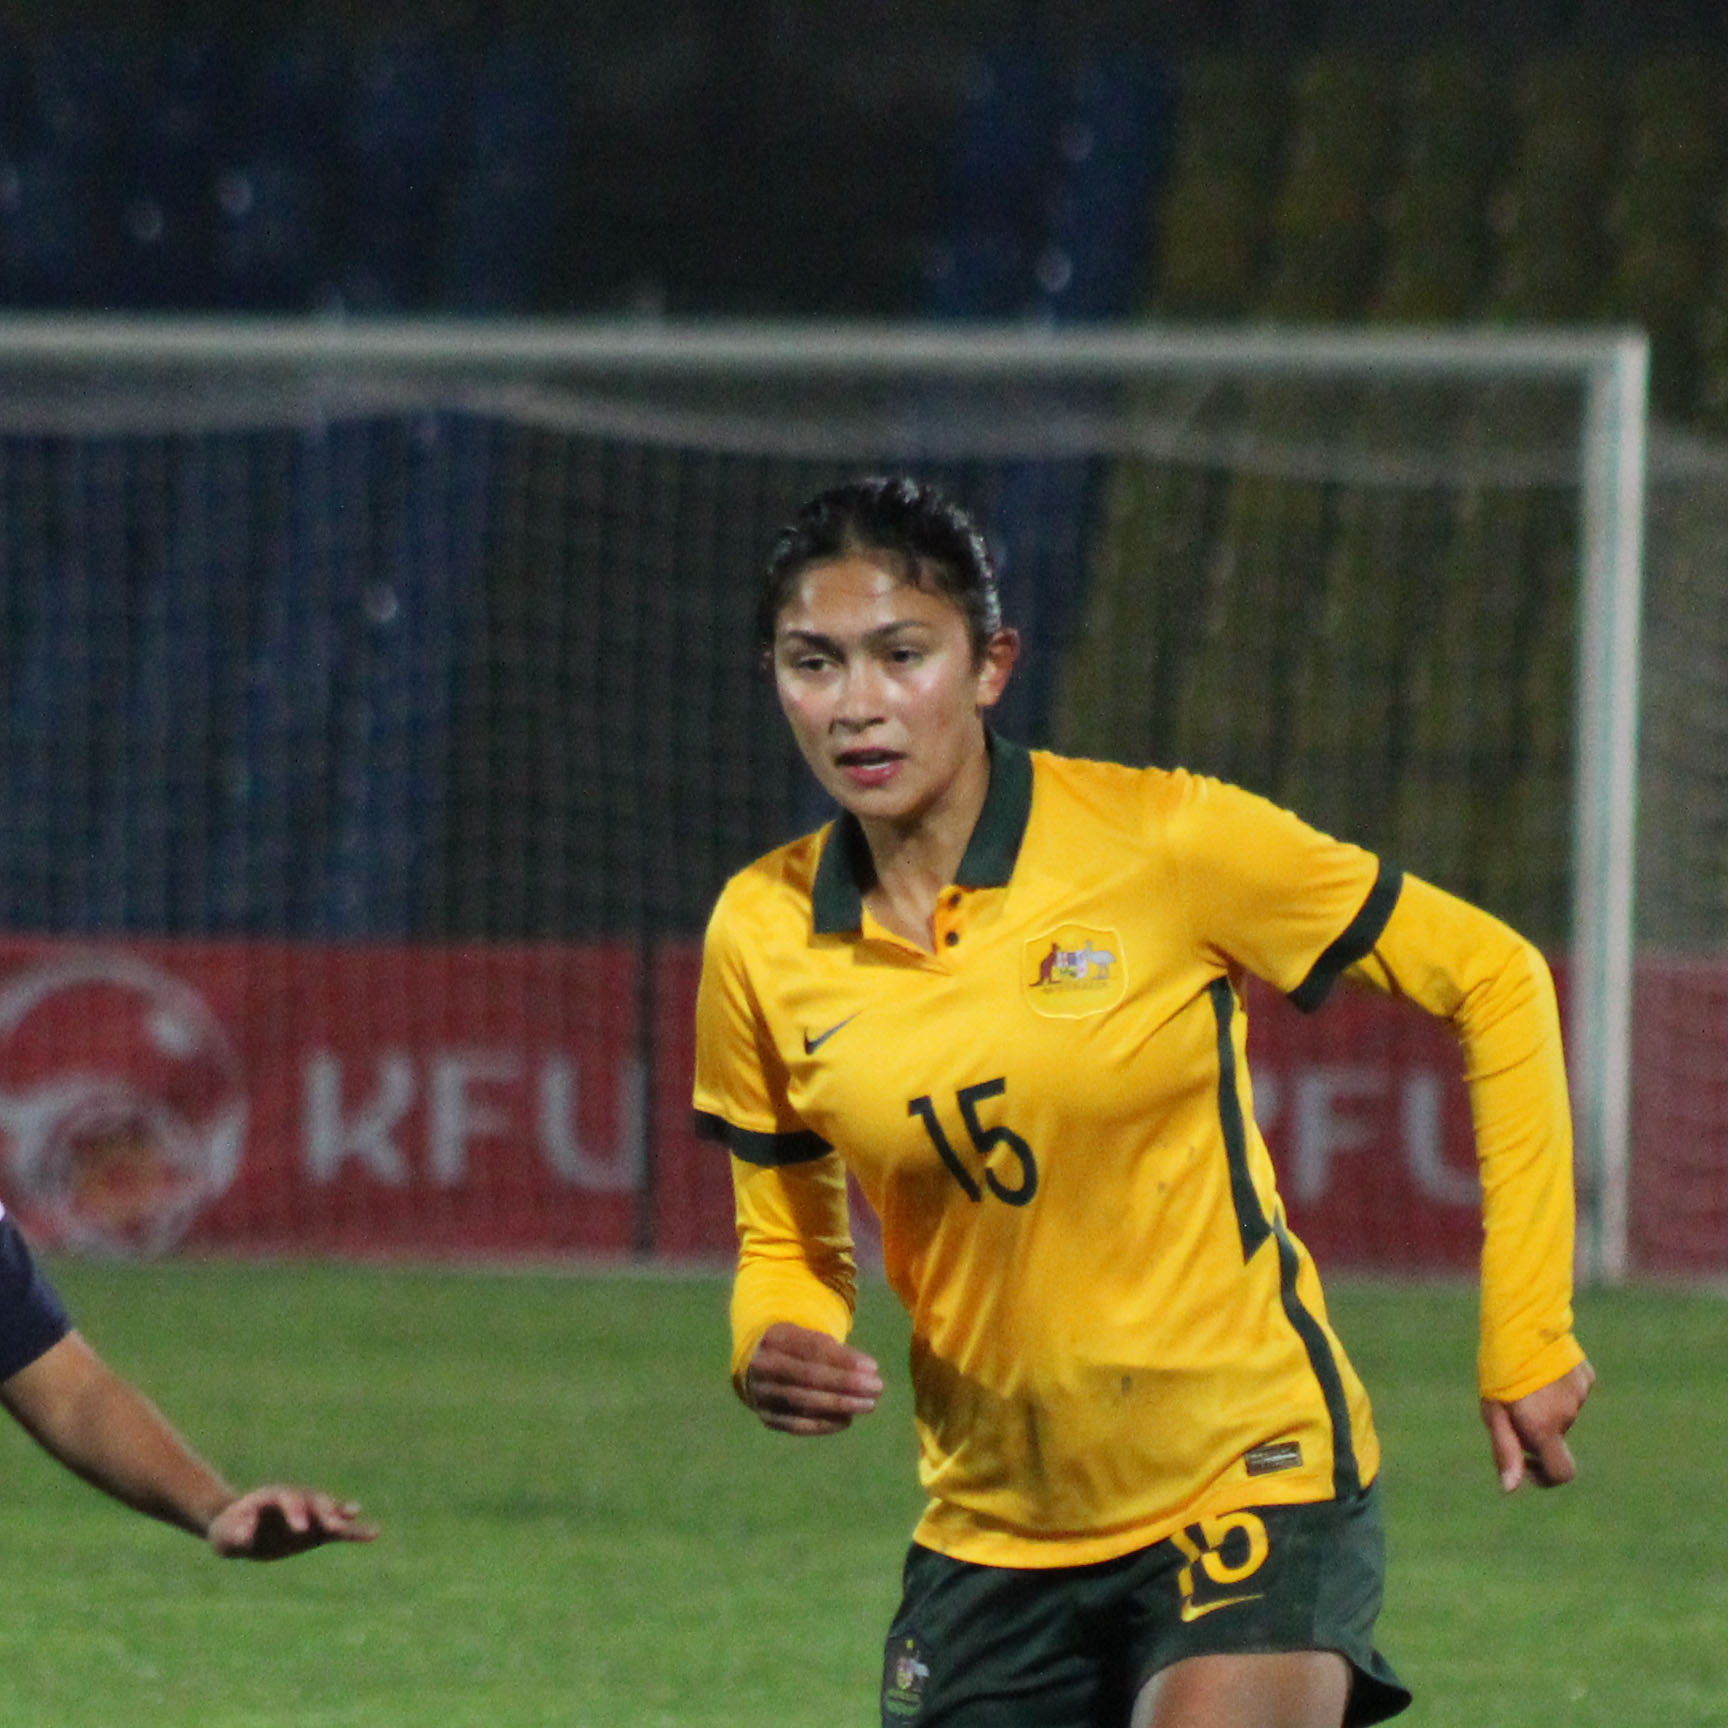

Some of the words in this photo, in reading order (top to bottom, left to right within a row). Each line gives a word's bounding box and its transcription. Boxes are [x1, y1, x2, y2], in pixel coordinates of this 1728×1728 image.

[300, 1045, 650, 1194] KFU
[908, 1076, 1039, 1207] 15
[1252, 1062, 1482, 1206] FU
